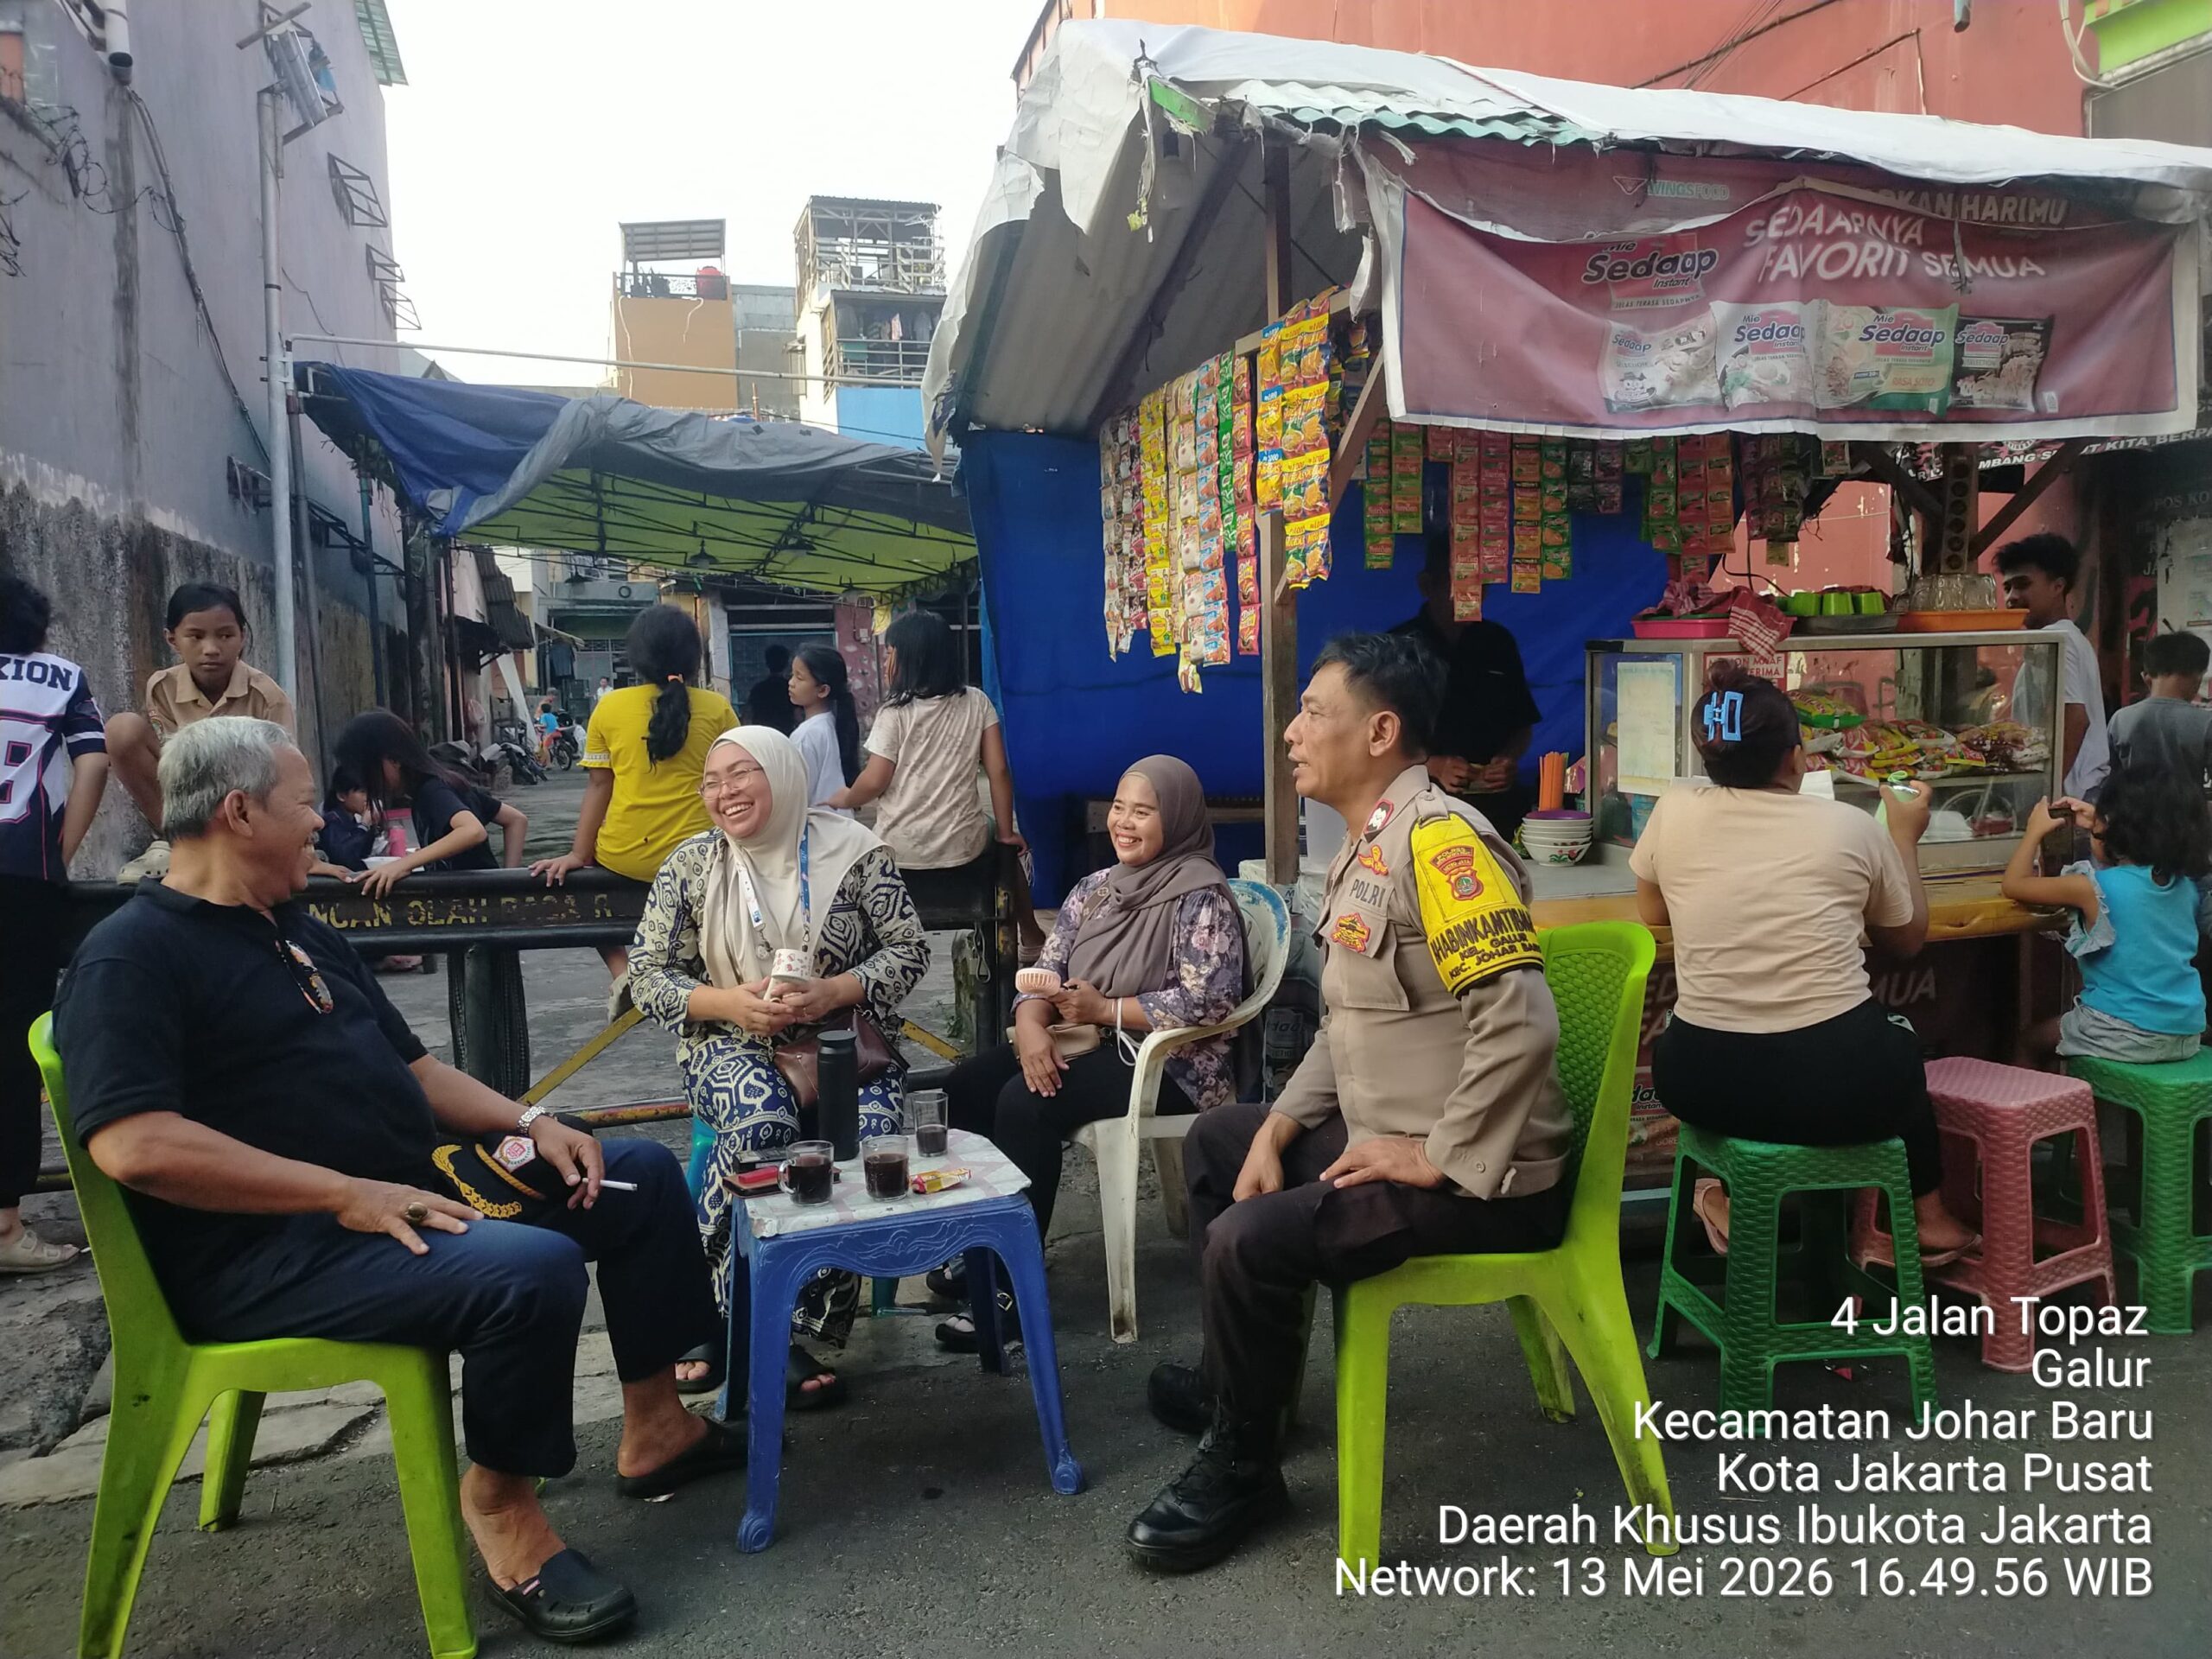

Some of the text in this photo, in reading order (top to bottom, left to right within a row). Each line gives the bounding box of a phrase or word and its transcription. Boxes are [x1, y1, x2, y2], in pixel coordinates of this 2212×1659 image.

[1961, 192, 2069, 225] HARIMU
[1744, 200, 1925, 249] SEDAAPNYA
[1581, 247, 1719, 284] Sedaap
[1758, 240, 2047, 283] FAVORIT SEMUA
[1653, 277, 1691, 289] Instant
[1873, 313, 1894, 324] Mie
[1611, 334, 1652, 353] Sedaap
[1859, 324, 1946, 346] Sedaap
[1955, 331, 2009, 345] Sedaap
[2103, 437, 2149, 452] KITA
[1349, 878, 1387, 908] POLRI
[1459, 933, 1529, 962] KEL. GALUR
[1475, 944, 1519, 966] JOHAR
